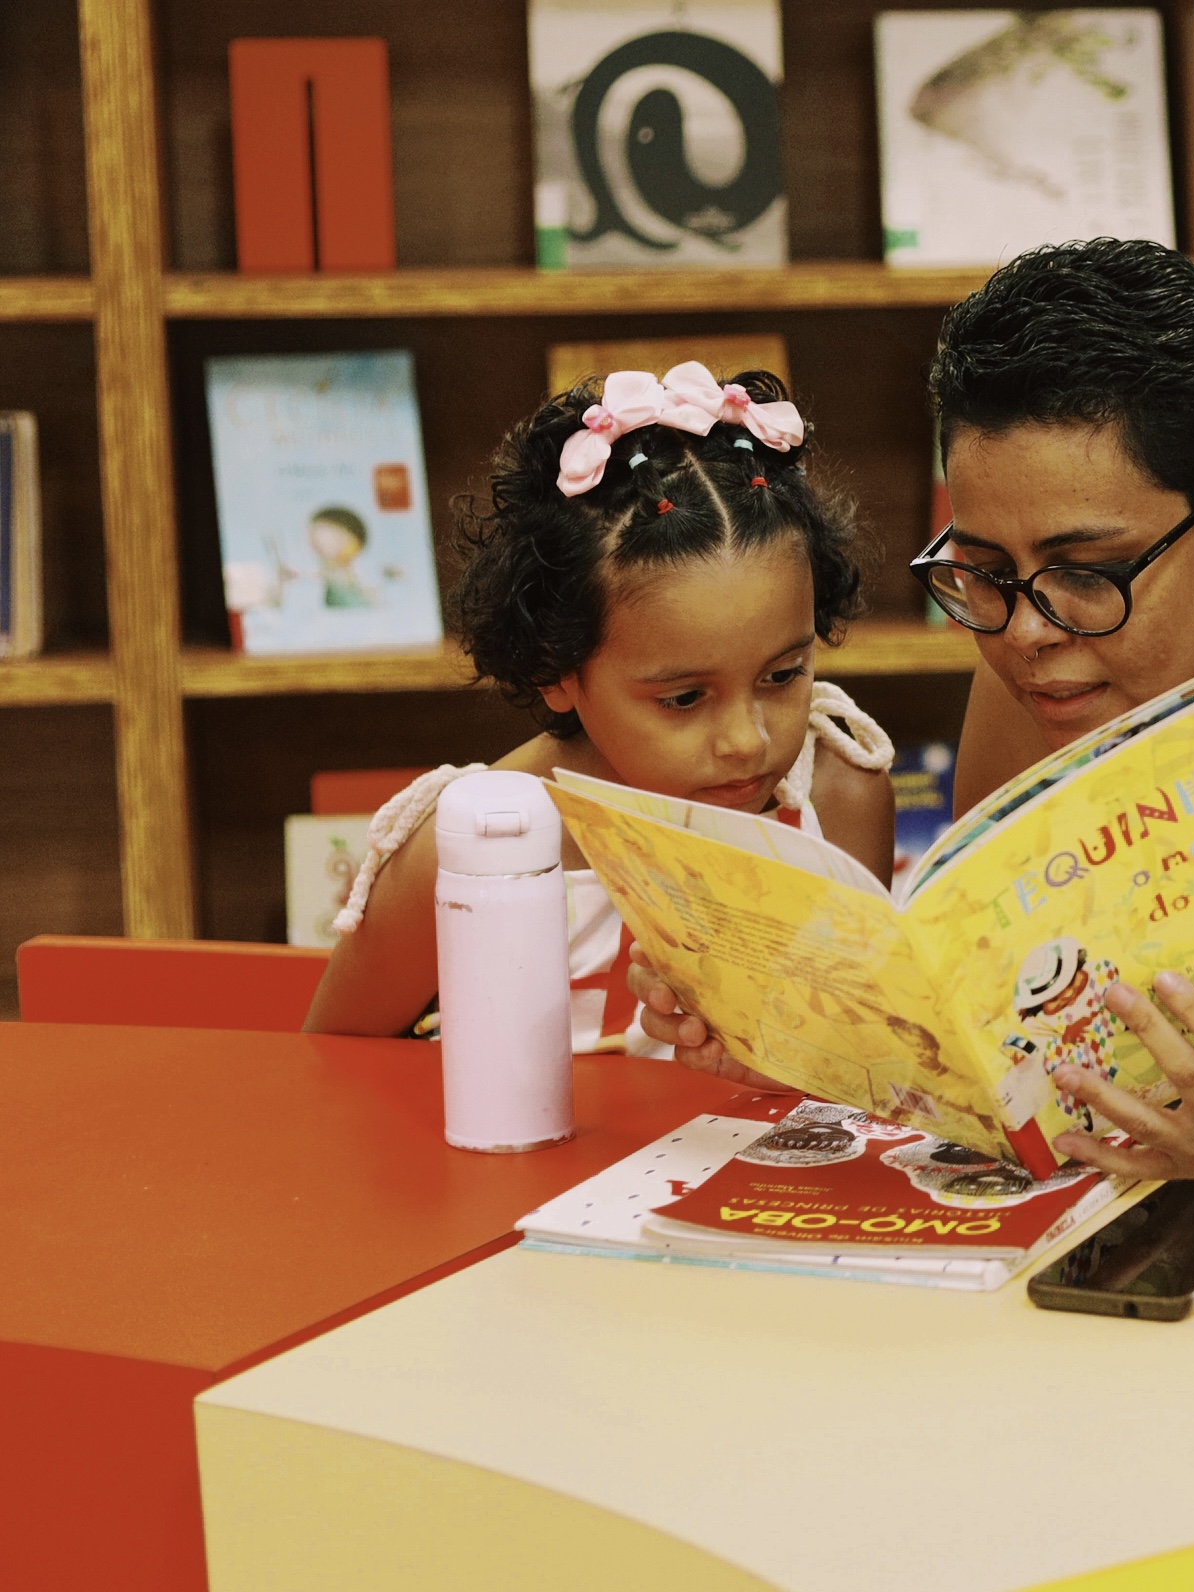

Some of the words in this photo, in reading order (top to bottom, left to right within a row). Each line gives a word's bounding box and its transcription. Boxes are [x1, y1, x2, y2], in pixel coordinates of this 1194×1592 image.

[1132, 868, 1151, 887] o
[1148, 890, 1191, 923] do
[728, 1196, 850, 1211] PRINCESAS
[856, 1204, 887, 1213] DE
[752, 1228, 823, 1240] Oliveira
[828, 1233, 850, 1241] de
